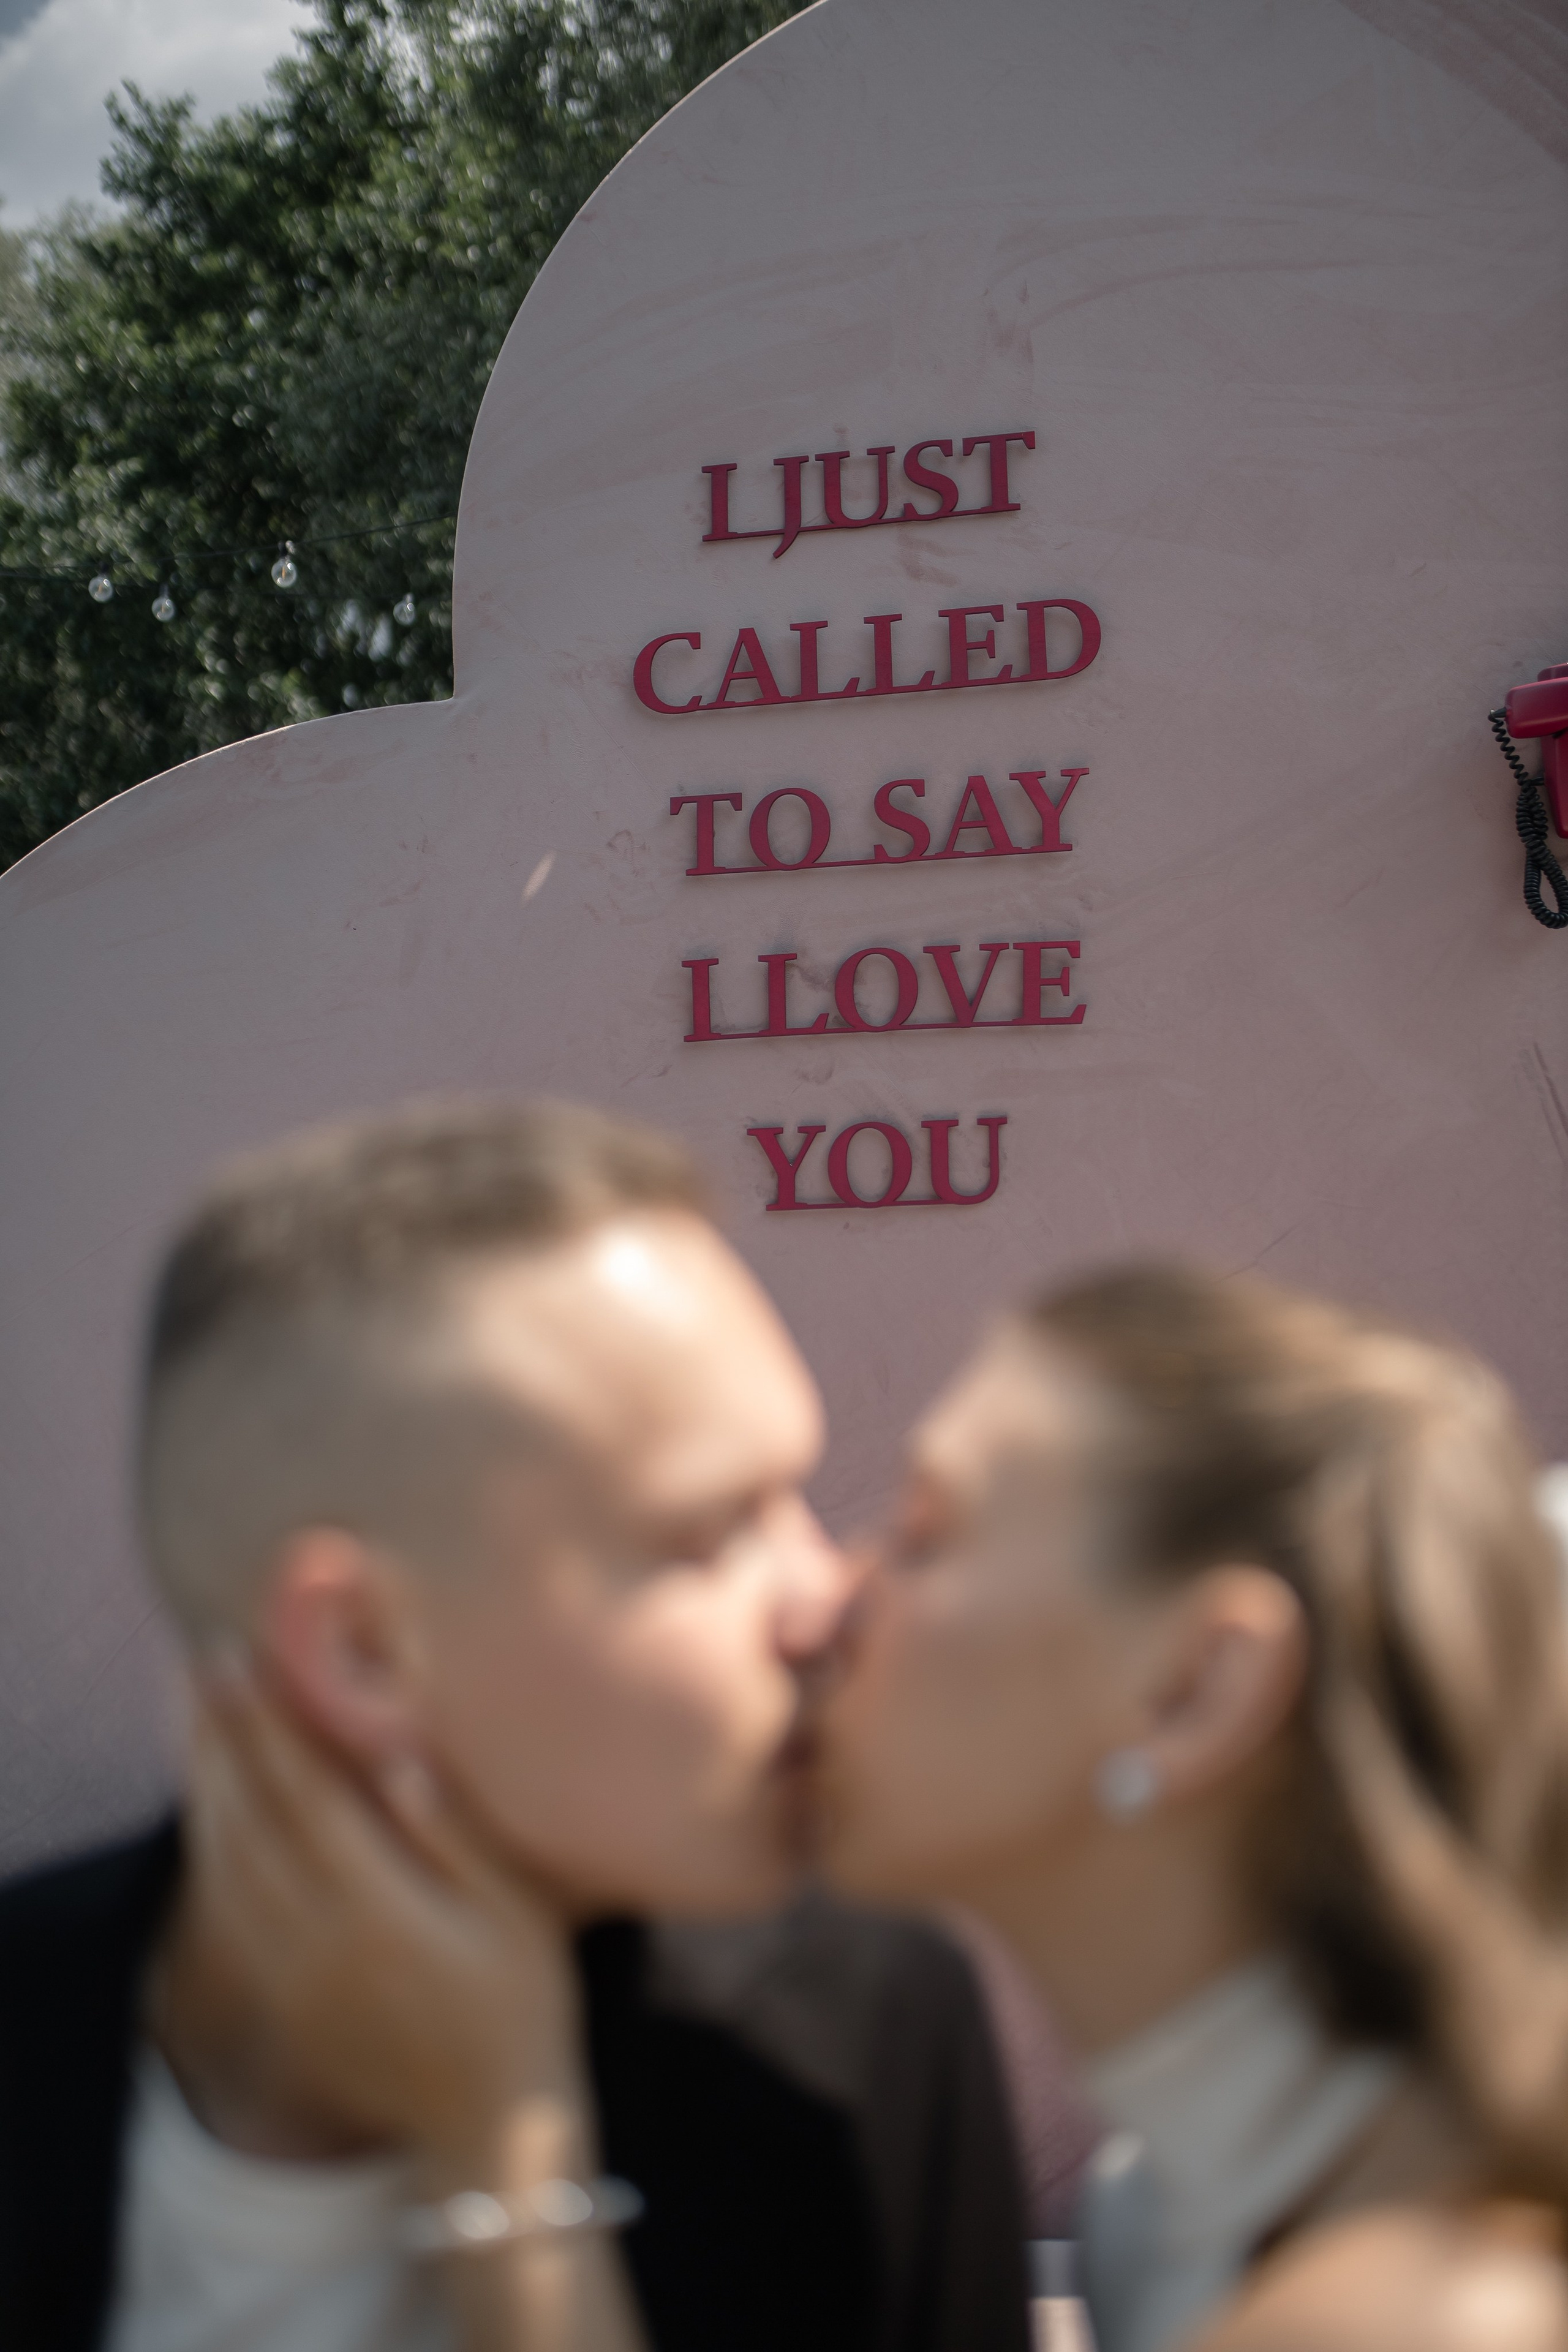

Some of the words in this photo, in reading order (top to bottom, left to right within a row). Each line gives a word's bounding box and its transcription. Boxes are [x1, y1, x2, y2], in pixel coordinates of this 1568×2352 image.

[701, 463, 737, 542] I
[772, 431, 1036, 559] JUST
[633, 598, 1101, 714] CALLED
[670, 788, 831, 876] TO
[873, 767, 1090, 864] SAY
[681, 957, 719, 1042] I
[758, 940, 1087, 1033] LOVE
[747, 1117, 1008, 1212] YOU
